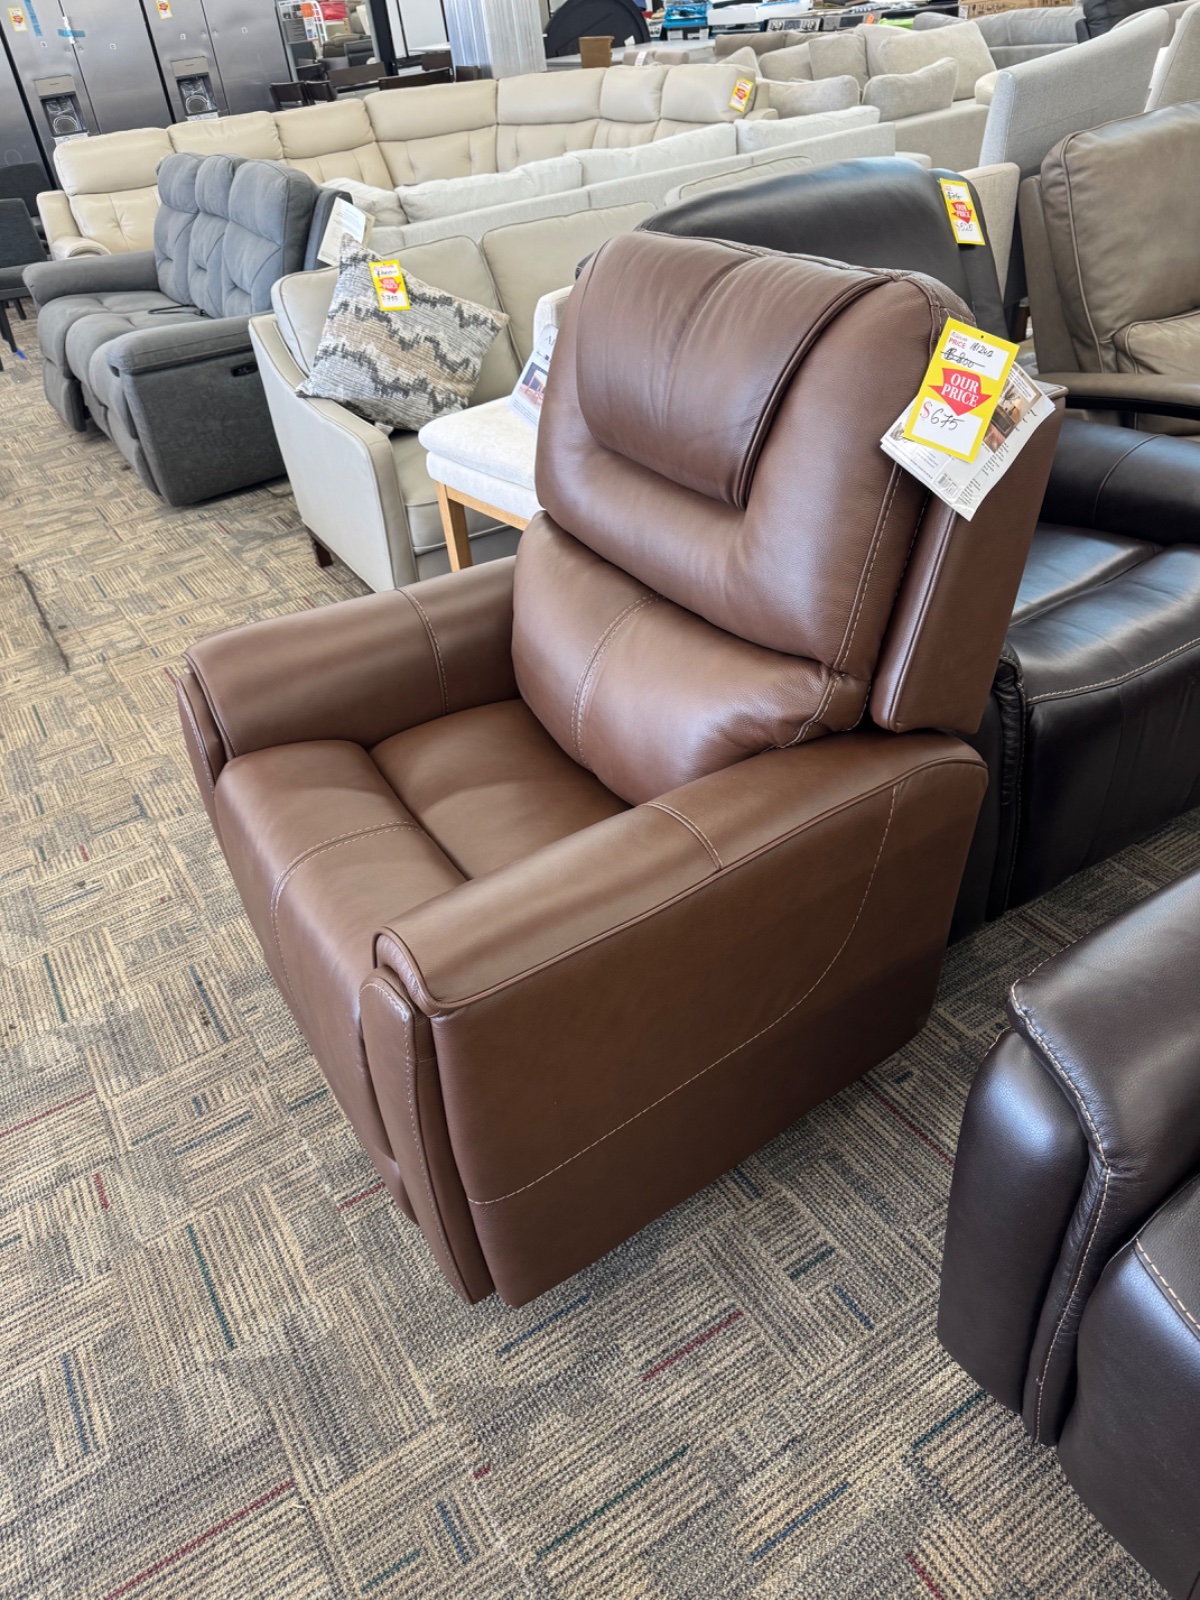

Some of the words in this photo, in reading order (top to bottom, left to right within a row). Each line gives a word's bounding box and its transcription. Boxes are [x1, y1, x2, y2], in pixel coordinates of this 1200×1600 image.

[949, 337, 967, 349] PRICE
[950, 373, 979, 394] OUR
[941, 383, 979, 408] PRICE
